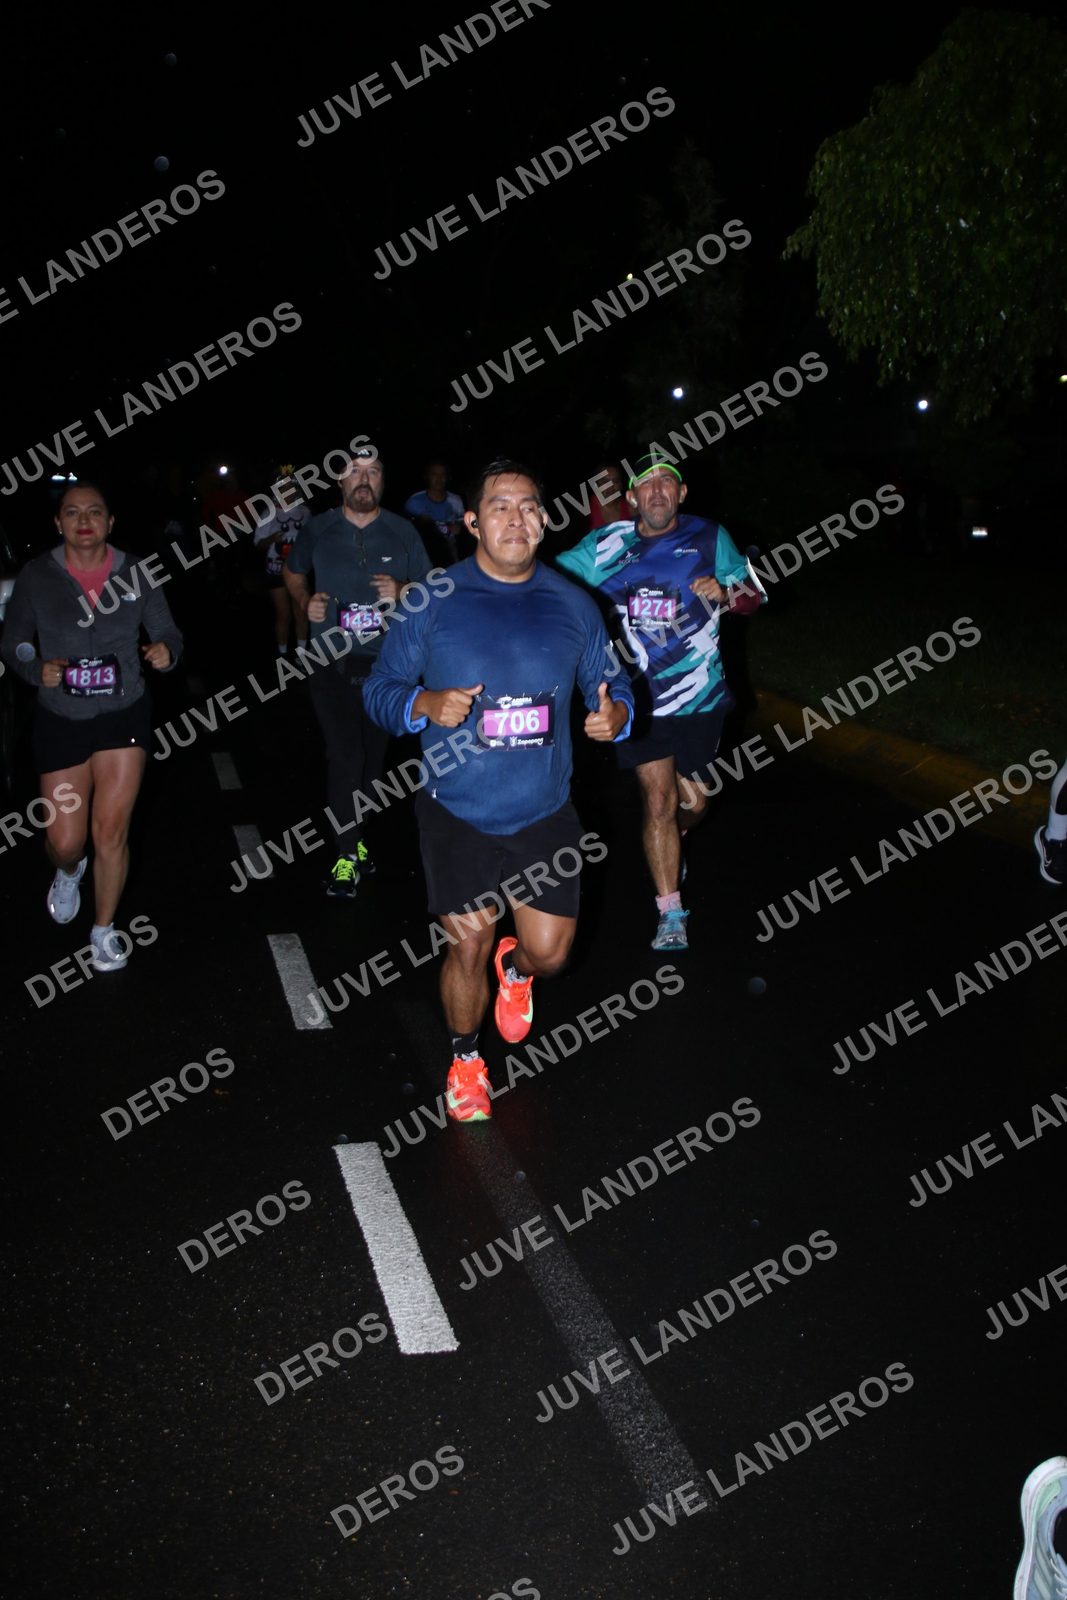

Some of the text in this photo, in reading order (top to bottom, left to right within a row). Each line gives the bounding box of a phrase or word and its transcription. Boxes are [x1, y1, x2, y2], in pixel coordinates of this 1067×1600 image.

[631, 598, 673, 616] 1271
[343, 611, 382, 628] 1455
[69, 667, 114, 686] 1813
[495, 709, 540, 735] 706
